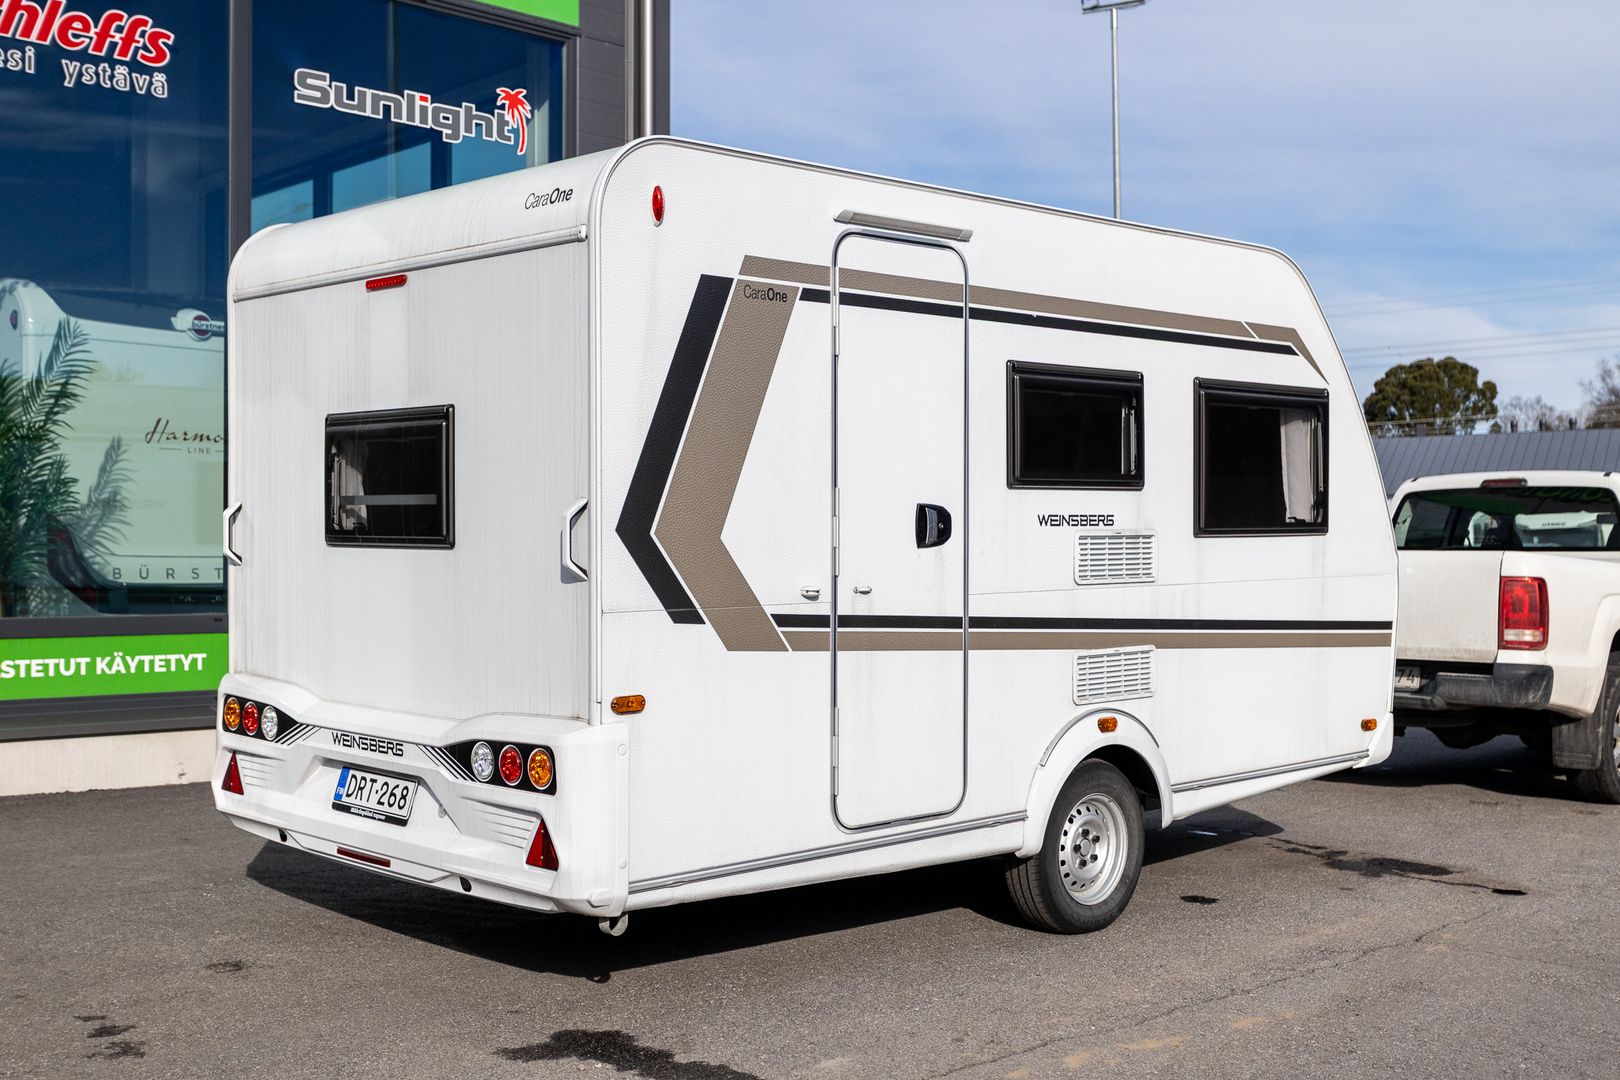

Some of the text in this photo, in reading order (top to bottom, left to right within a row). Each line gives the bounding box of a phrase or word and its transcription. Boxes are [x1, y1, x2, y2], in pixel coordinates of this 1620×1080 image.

[0, 0, 175, 67] hleffs
[61, 58, 168, 98] ystävä
[294, 68, 514, 144] Sunlight
[524, 187, 573, 210] CaraOne
[743, 284, 788, 303] CaraOne
[1037, 514, 1115, 527] WEINSBERG
[96, 652, 207, 675] KÄYTETYT
[331, 731, 404, 757] WEINSBERG
[345, 773, 410, 811] DRT-268
